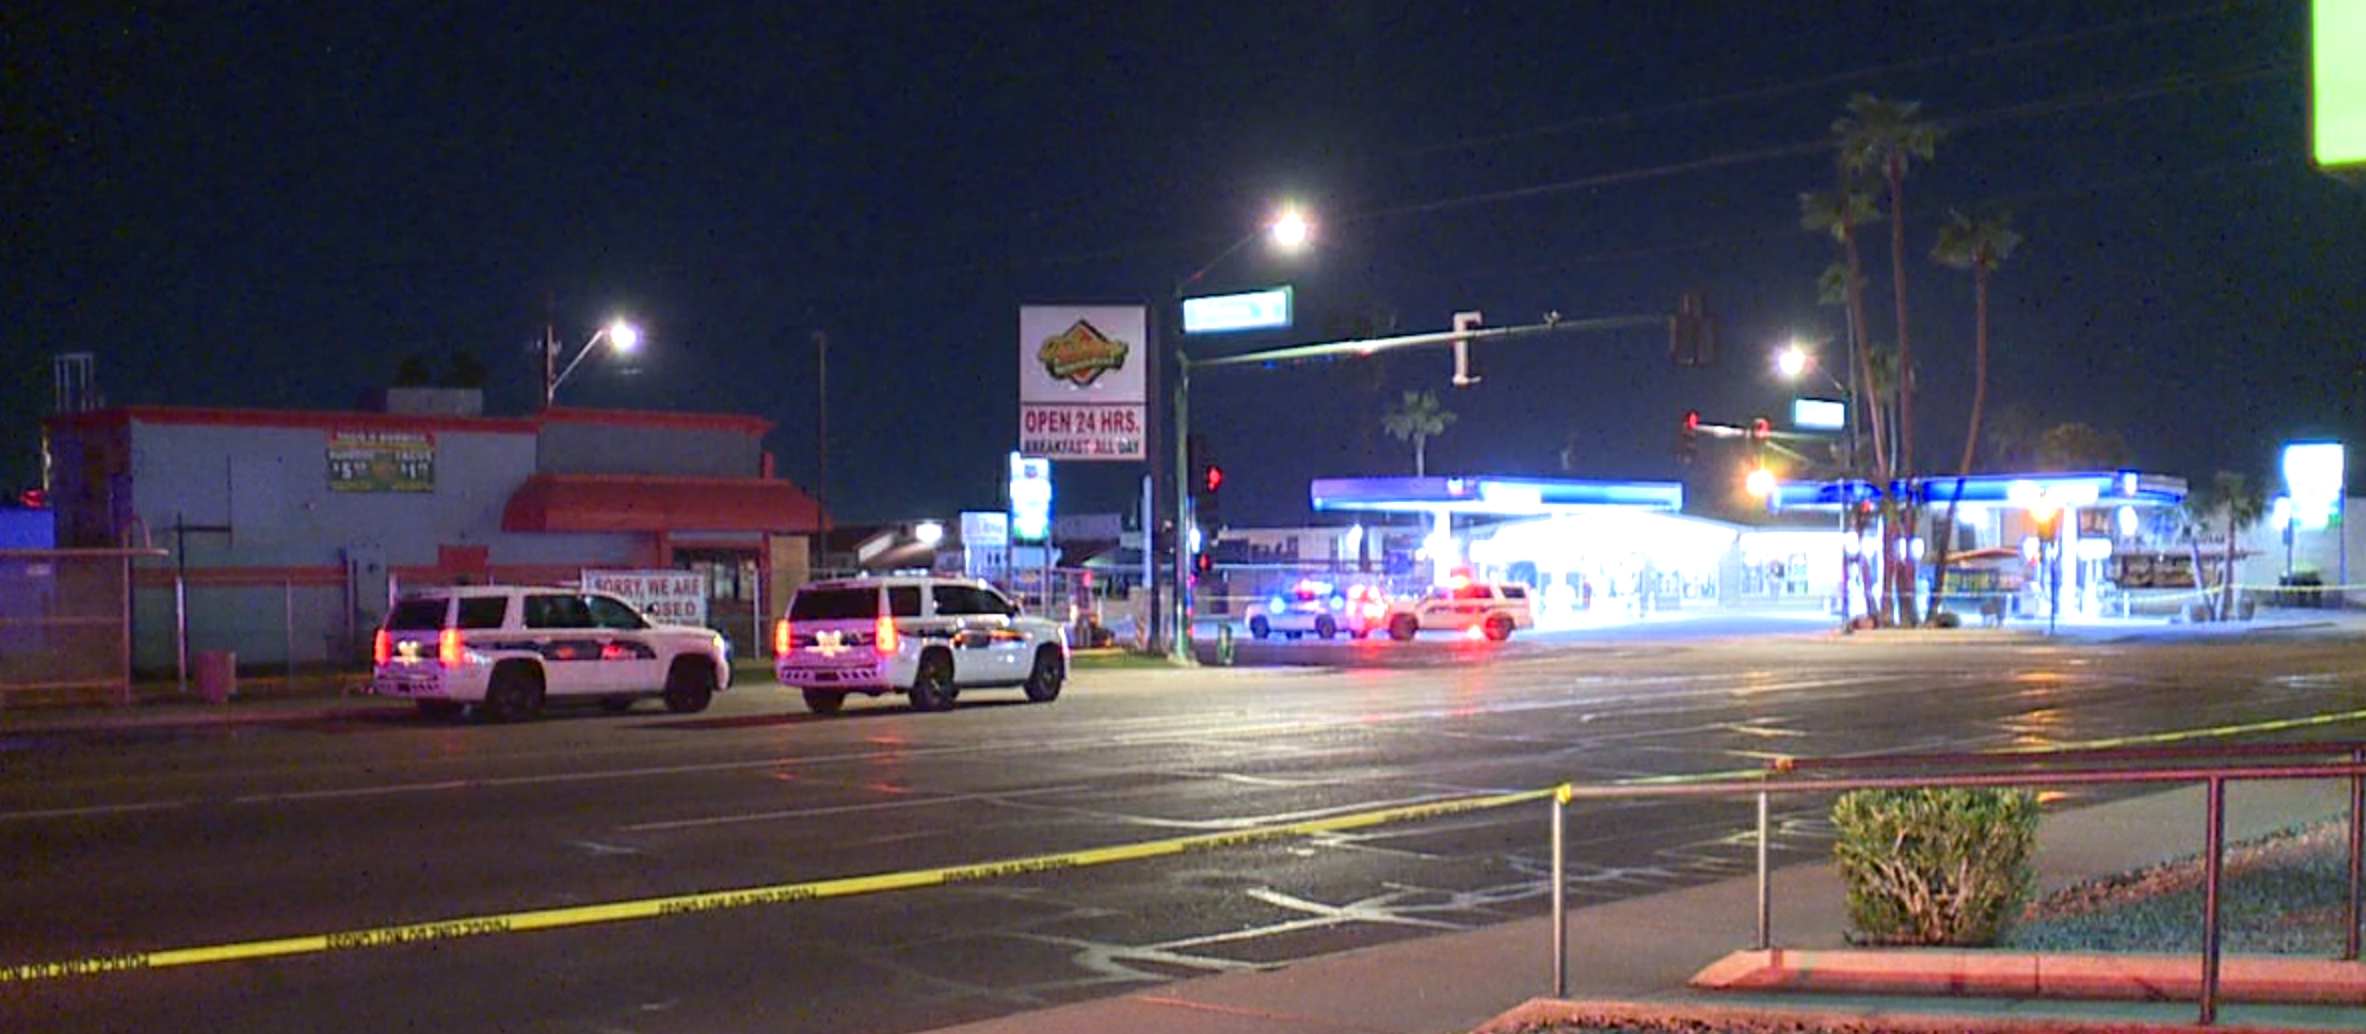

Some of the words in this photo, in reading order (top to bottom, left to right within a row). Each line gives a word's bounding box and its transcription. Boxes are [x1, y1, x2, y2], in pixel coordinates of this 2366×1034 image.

[1025, 410, 1071, 433] OPEN
[1075, 410, 1095, 434] 24
[1101, 410, 1141, 433] HRS.
[1093, 439, 1115, 454] ALL
[649, 579, 670, 596] WE
[674, 579, 700, 596] ARE
